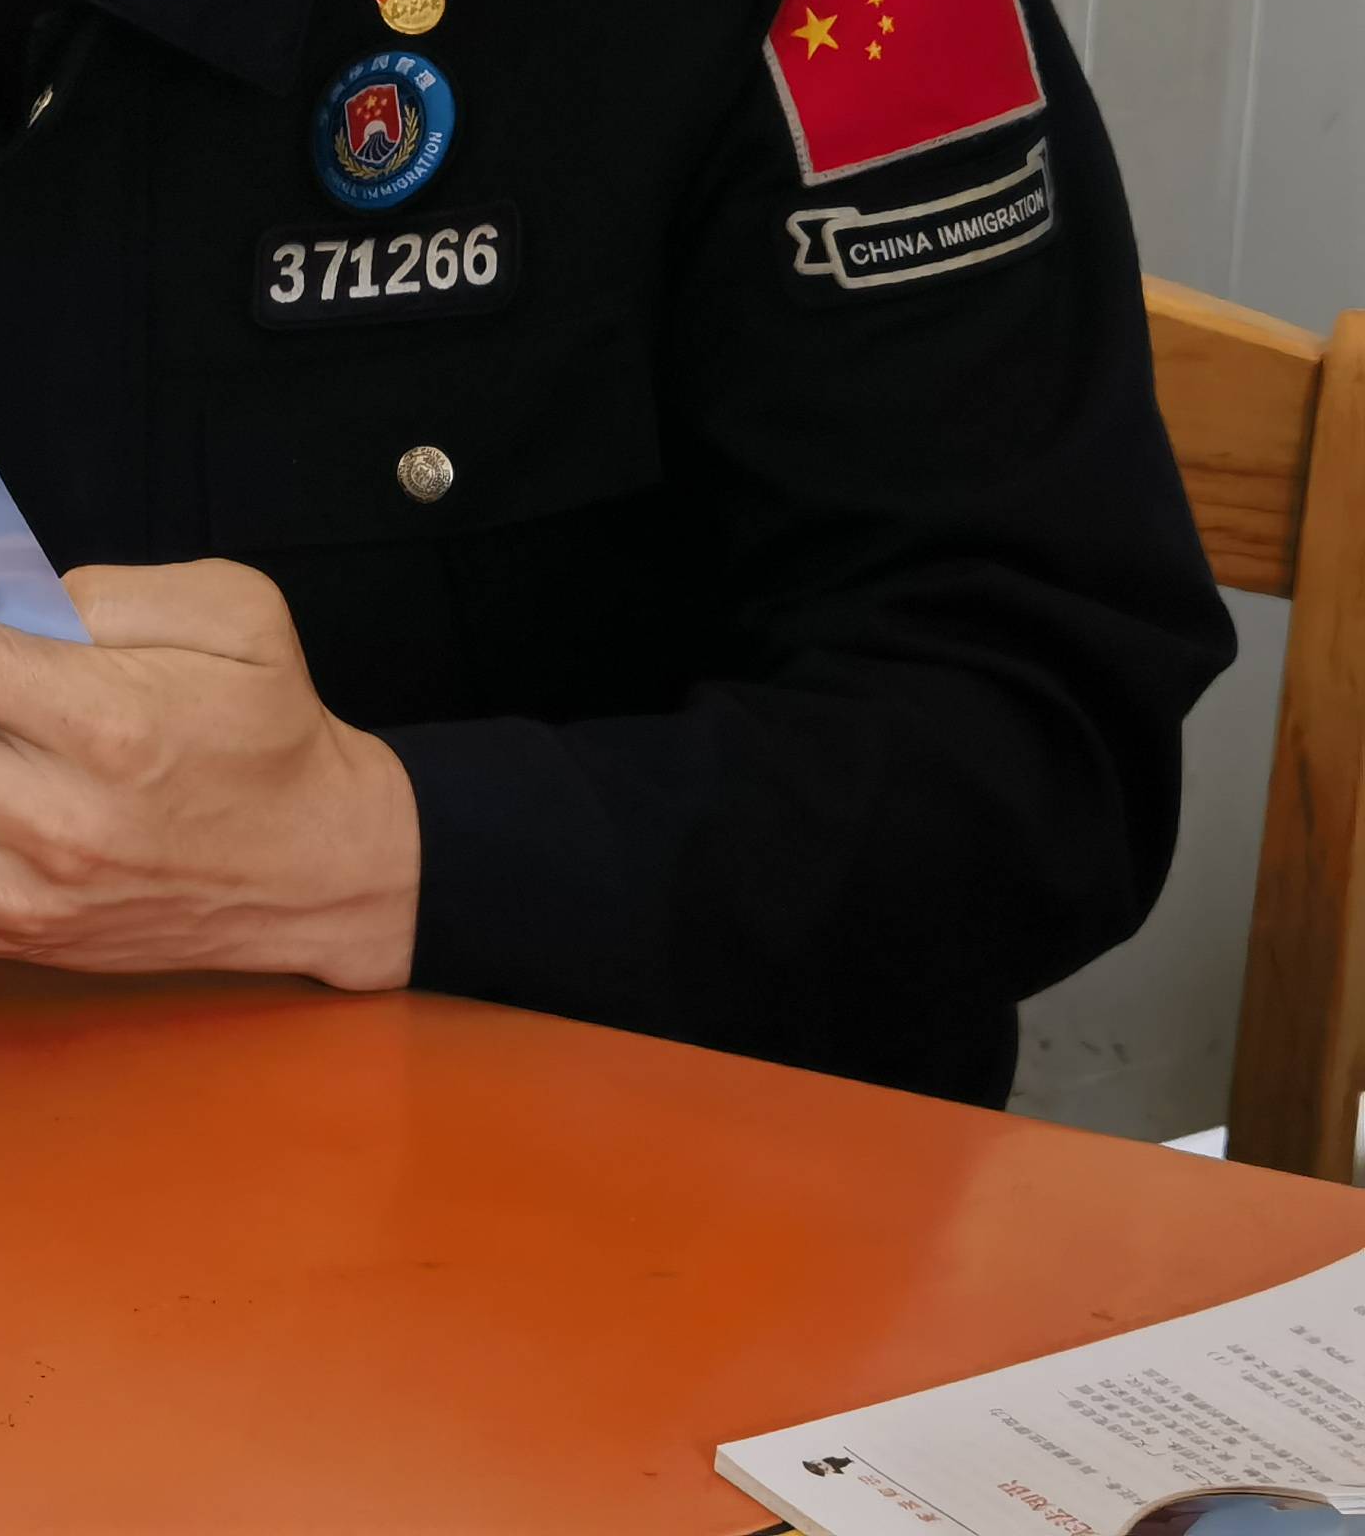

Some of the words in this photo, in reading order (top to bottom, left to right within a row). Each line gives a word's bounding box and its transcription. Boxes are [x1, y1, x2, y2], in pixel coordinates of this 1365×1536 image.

[269, 223, 500, 304] 371266
[848, 232, 933, 265] CHINA
[937, 189, 1045, 248] IMMIGRATION
